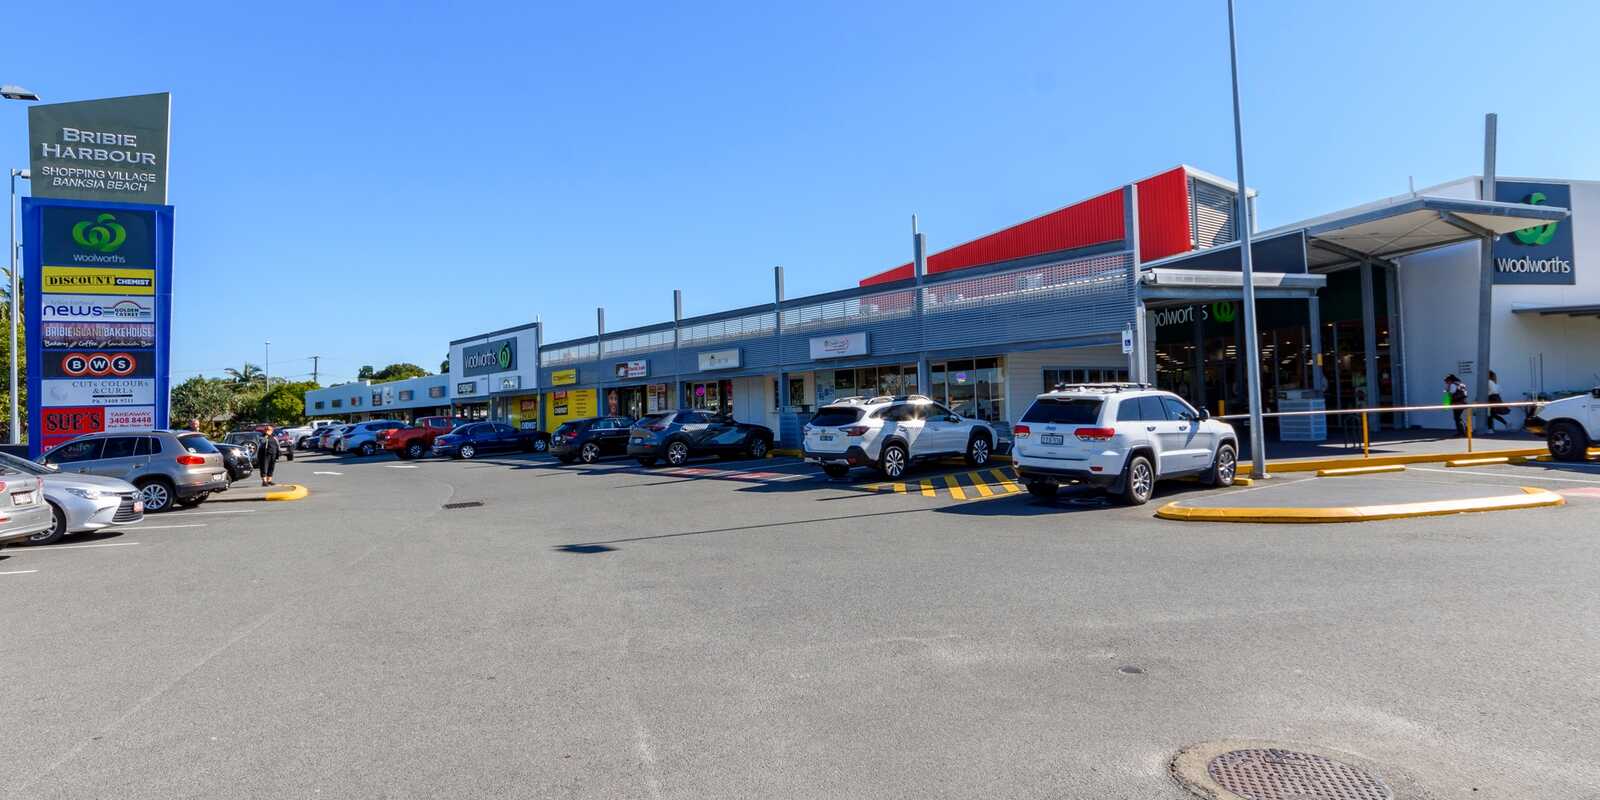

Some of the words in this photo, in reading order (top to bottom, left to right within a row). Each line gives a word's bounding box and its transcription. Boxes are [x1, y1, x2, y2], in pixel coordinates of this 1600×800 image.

[62, 127, 137, 147] BRIBIE
[41, 142, 157, 165] HARBOUR
[42, 166, 105, 180] SHOPPING
[107, 170, 157, 183] VILLAGE
[53, 177, 105, 189] BANKSIA
[107, 181, 148, 192] BEACH
[73, 253, 126, 264] Woolworths
[1497, 256, 1571, 273] Woolworths
[48, 275, 115, 287] DISCOUNT
[116, 278, 150, 286] CHEMIST
[43, 305, 103, 317] news
